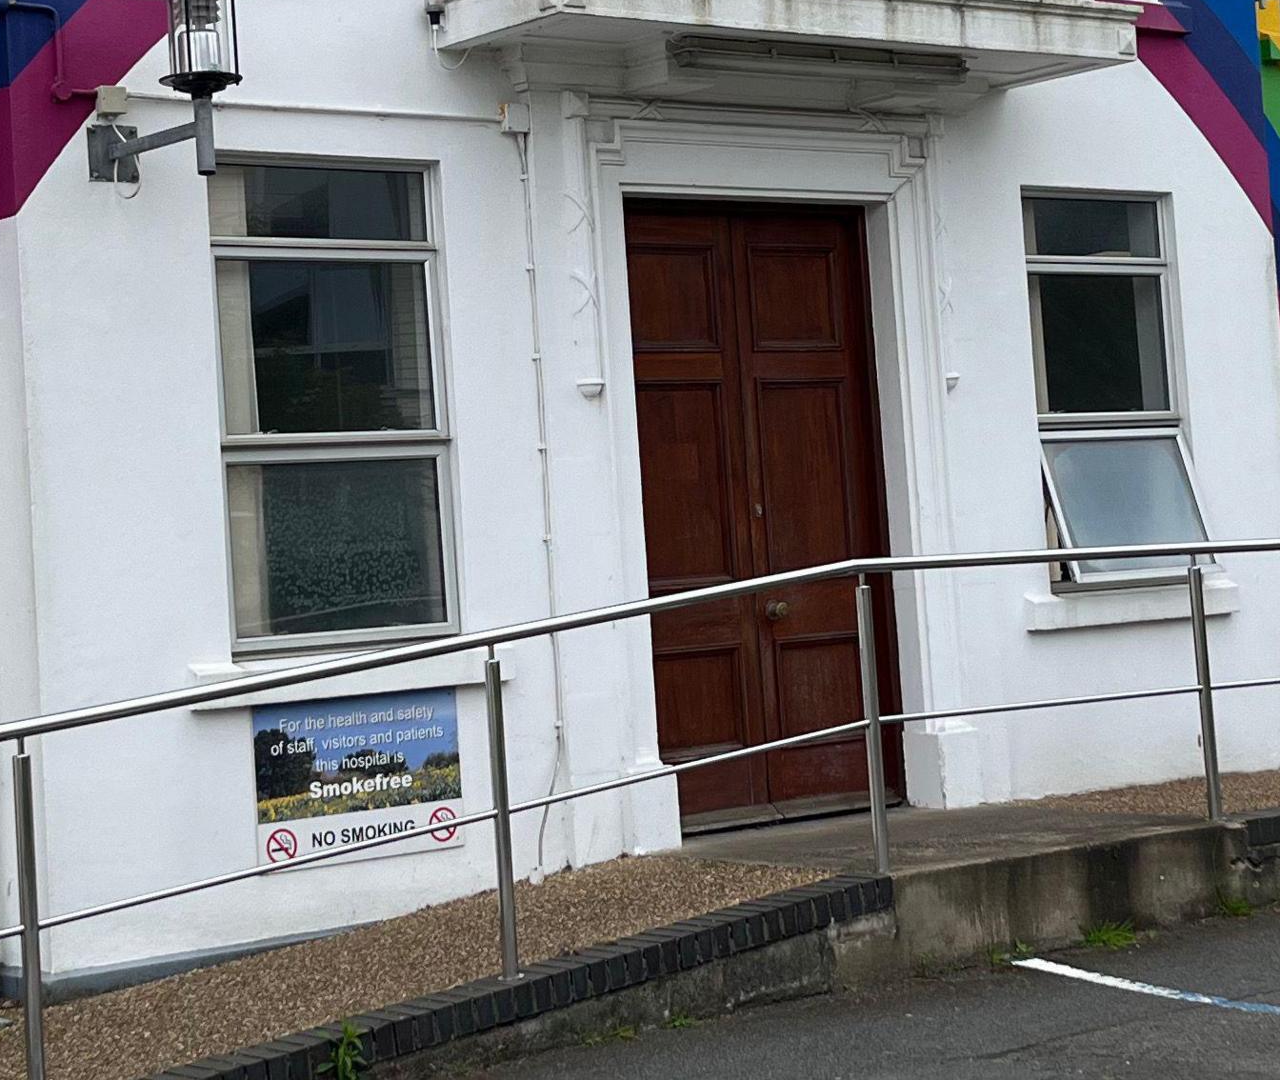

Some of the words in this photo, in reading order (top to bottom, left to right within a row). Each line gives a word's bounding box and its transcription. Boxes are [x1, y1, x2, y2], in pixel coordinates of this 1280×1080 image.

[279, 718, 302, 734] For
[304, 713, 325, 731] the
[328, 708, 368, 729] health
[370, 705, 394, 724] and
[397, 704, 434, 724] safety
[270, 739, 284, 757] of
[286, 735, 318, 755] staff,
[322, 731, 366, 751] visitors
[369, 727, 393, 746] and
[395, 724, 444, 745] patients
[315, 754, 339, 772] this
[341, 751, 390, 772] hospital
[393, 749, 405, 764] is
[309, 771, 414, 800] Smokefree
[311, 829, 336, 848] NO
[341, 819, 416, 845] SMOKING
